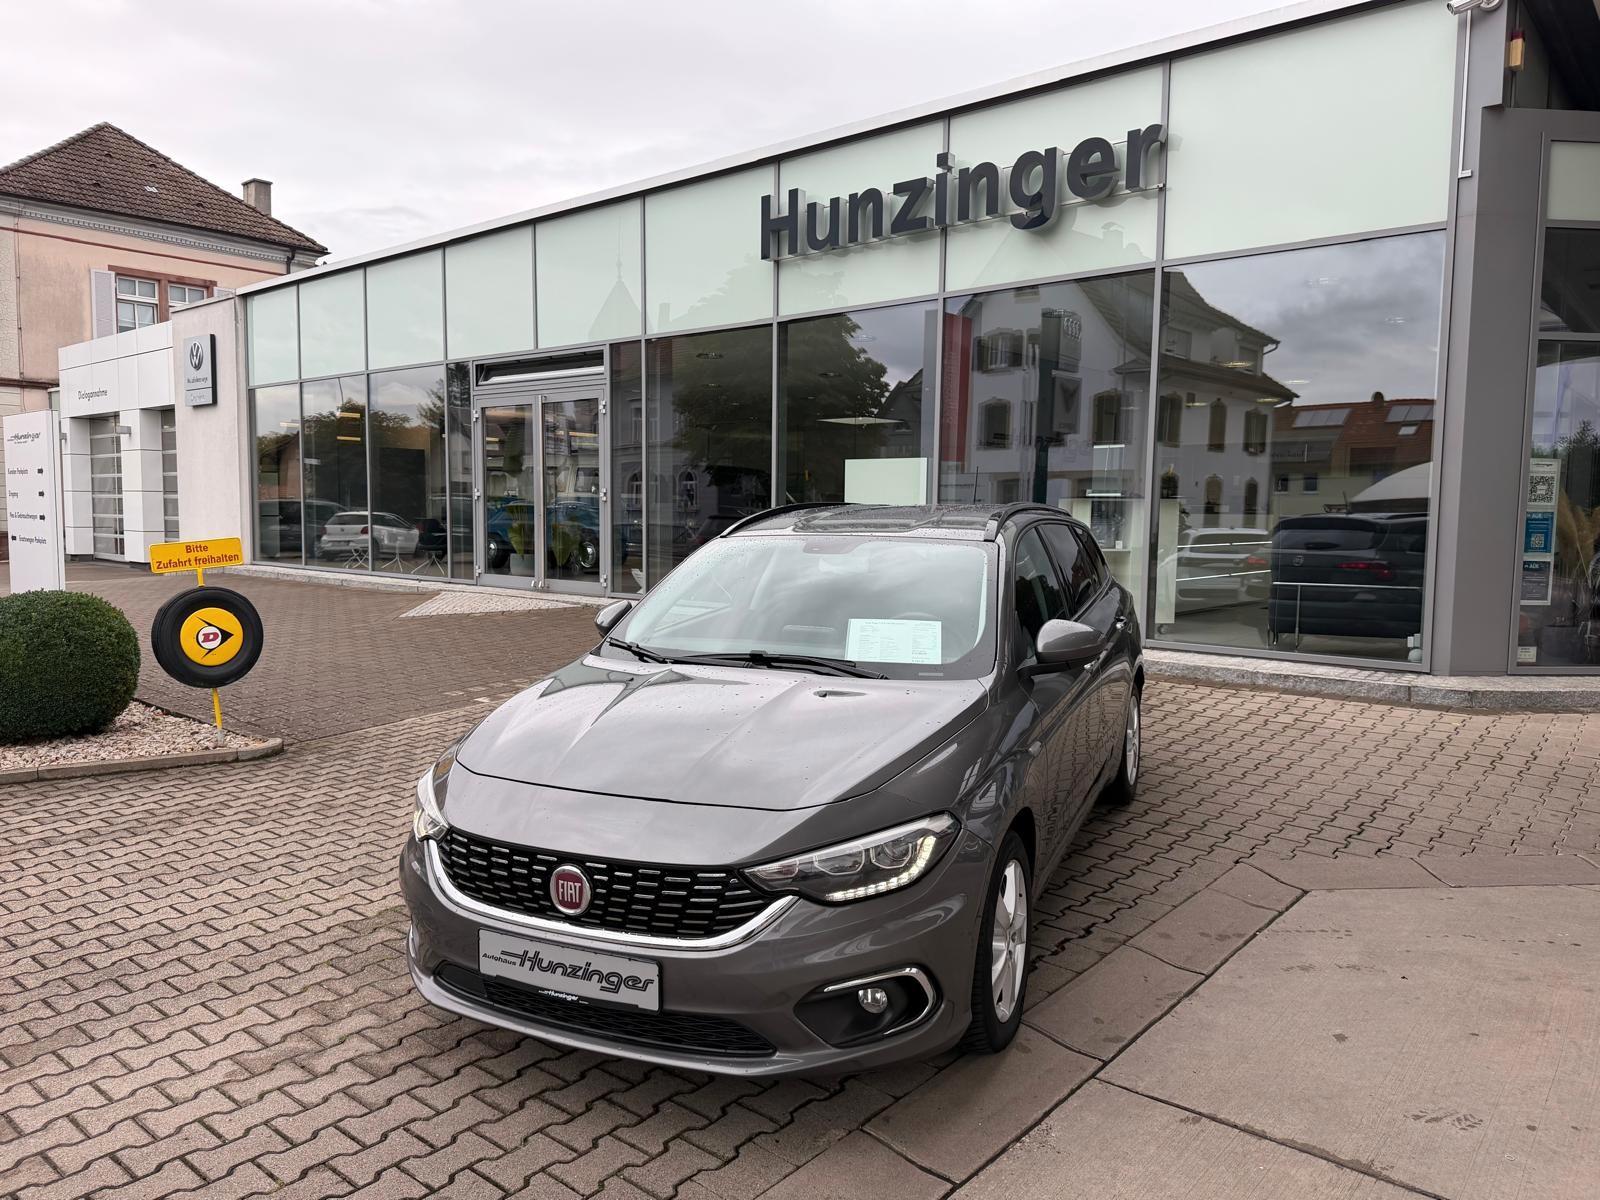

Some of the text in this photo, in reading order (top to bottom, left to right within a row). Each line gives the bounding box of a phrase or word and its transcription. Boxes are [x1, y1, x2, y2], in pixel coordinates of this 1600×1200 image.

[760, 123, 1167, 261] Hunzinger
[185, 544, 209, 554] Bitte
[156, 554, 239, 570] Zufahrt freihalten
[201, 631, 220, 643] D
[558, 879, 582, 904] FIAT
[481, 949, 655, 994] Autohaus Hunzinger
